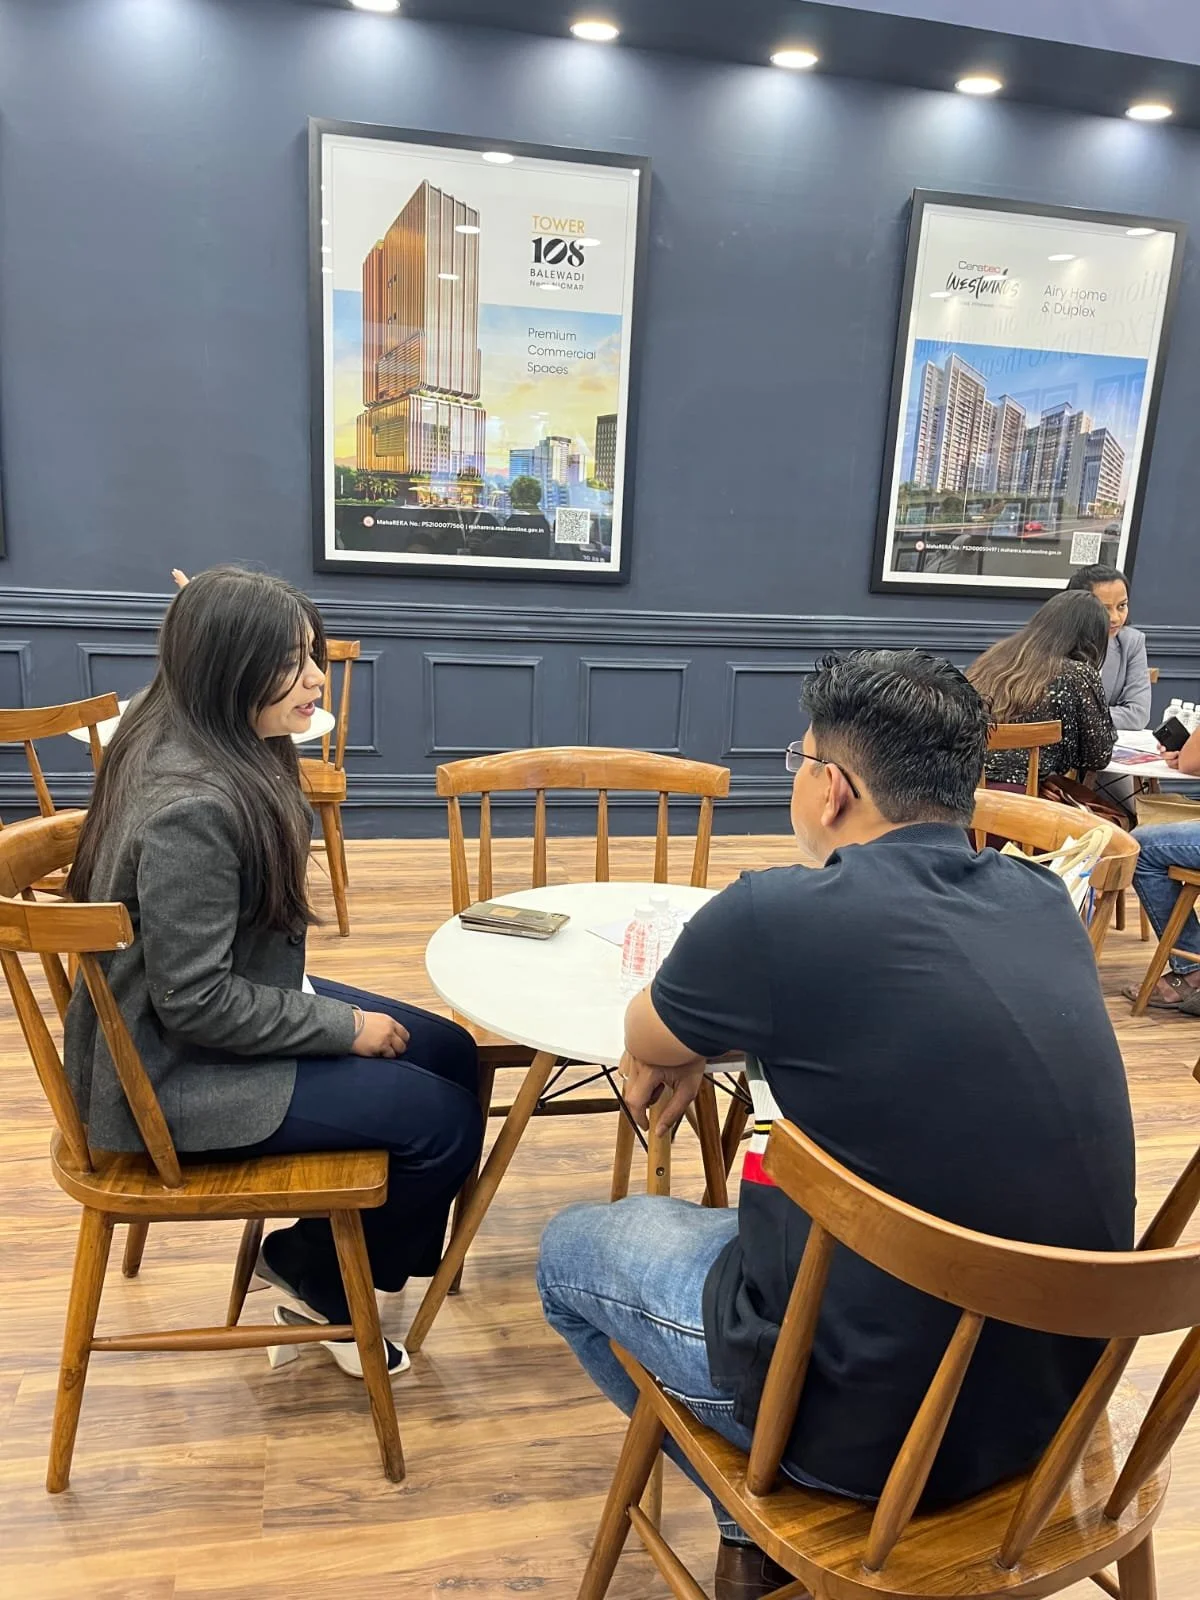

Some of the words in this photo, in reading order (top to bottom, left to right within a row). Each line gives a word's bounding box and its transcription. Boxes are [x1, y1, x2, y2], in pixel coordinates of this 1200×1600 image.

[532, 215, 585, 233] TOWER
[532, 236, 585, 268] 108
[530, 268, 585, 281] BALEWADI
[1044, 284, 1066, 299] Airy
[1071, 287, 1108, 302] Home
[1041, 301, 1049, 313] &
[1053, 303, 1096, 318] Duplex
[528, 327, 577, 342] Premium
[527, 344, 596, 361] Commercial
[527, 362, 569, 375] Spaces
